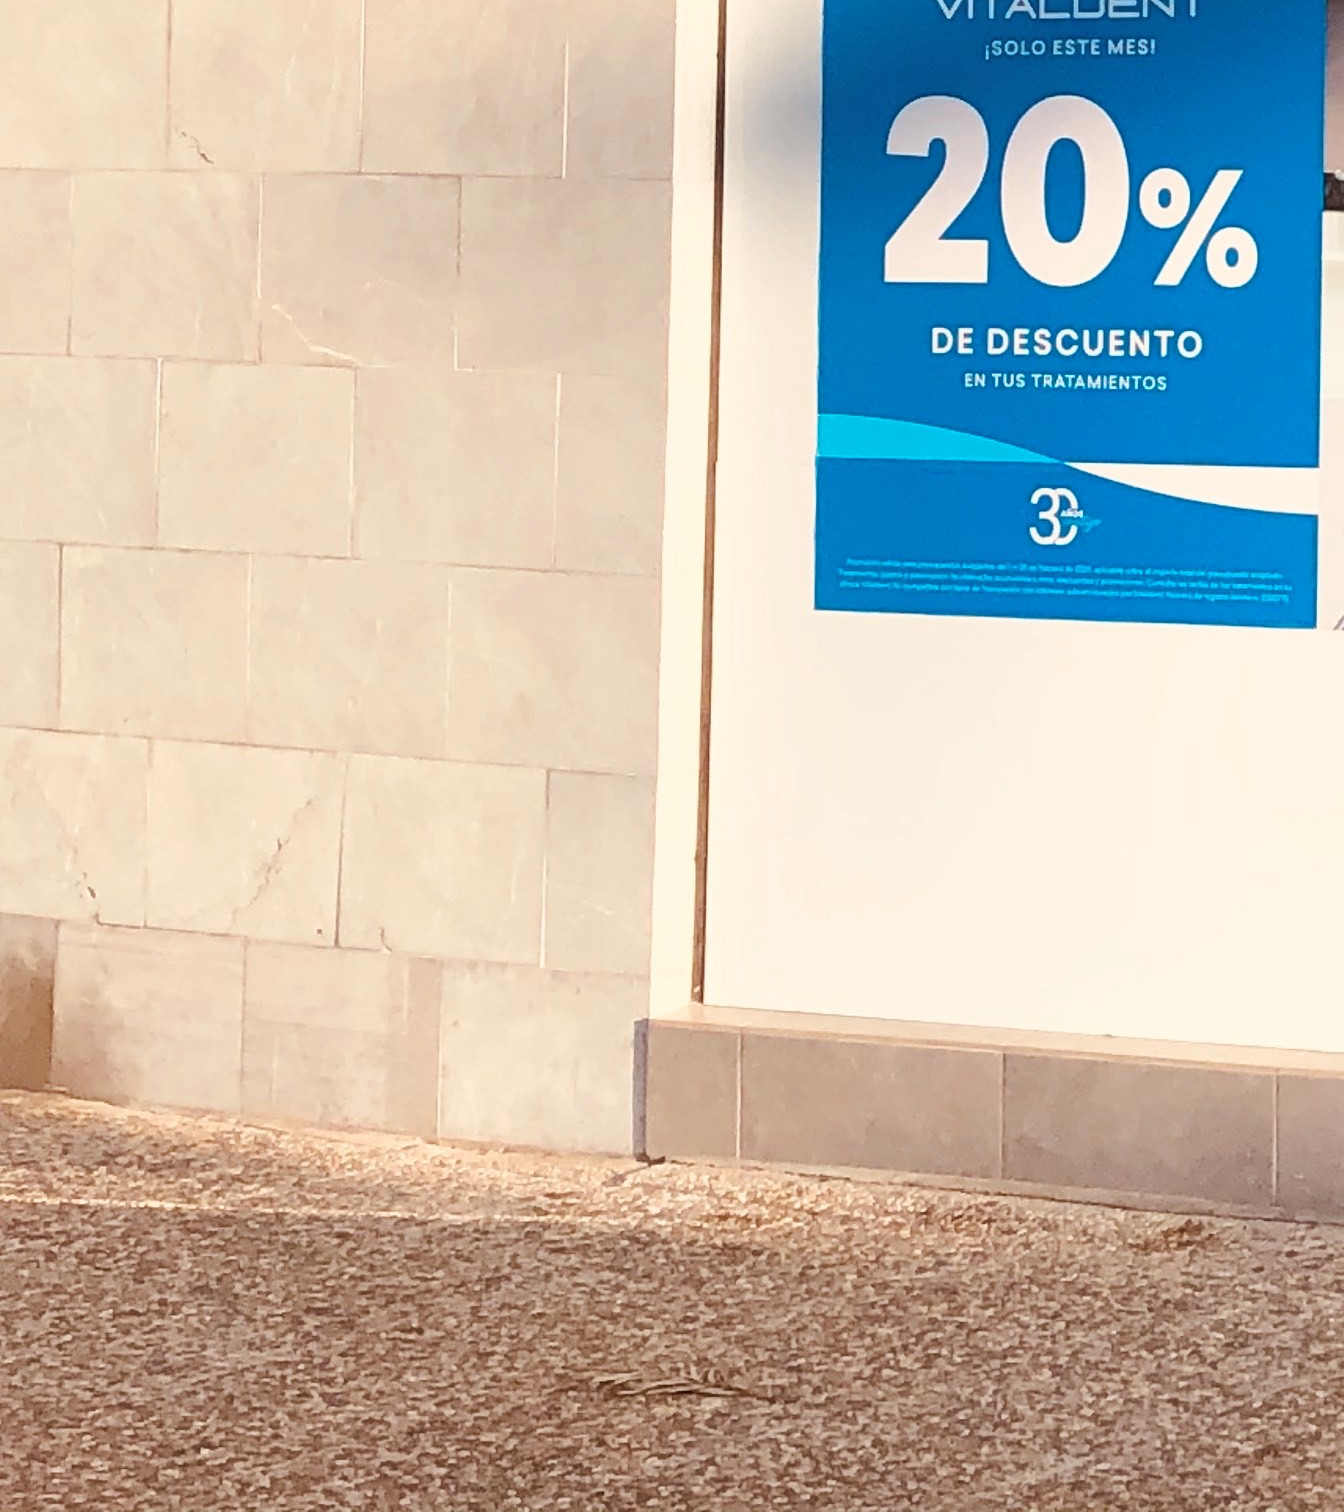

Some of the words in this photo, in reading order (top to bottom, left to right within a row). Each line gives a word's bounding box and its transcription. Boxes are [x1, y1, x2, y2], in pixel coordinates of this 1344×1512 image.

[984, 40, 1046, 61] ¡SOLO
[1052, 40, 1101, 56] ESTE
[1107, 39, 1157, 55] MES!
[883, 94, 1259, 289] 20%
[931, 328, 974, 356] DE
[986, 328, 1203, 359] DESCUENTO
[964, 373, 989, 389] EN
[991, 373, 1026, 389] TUS
[1031, 374, 1168, 392] TRATAMIENTOS
